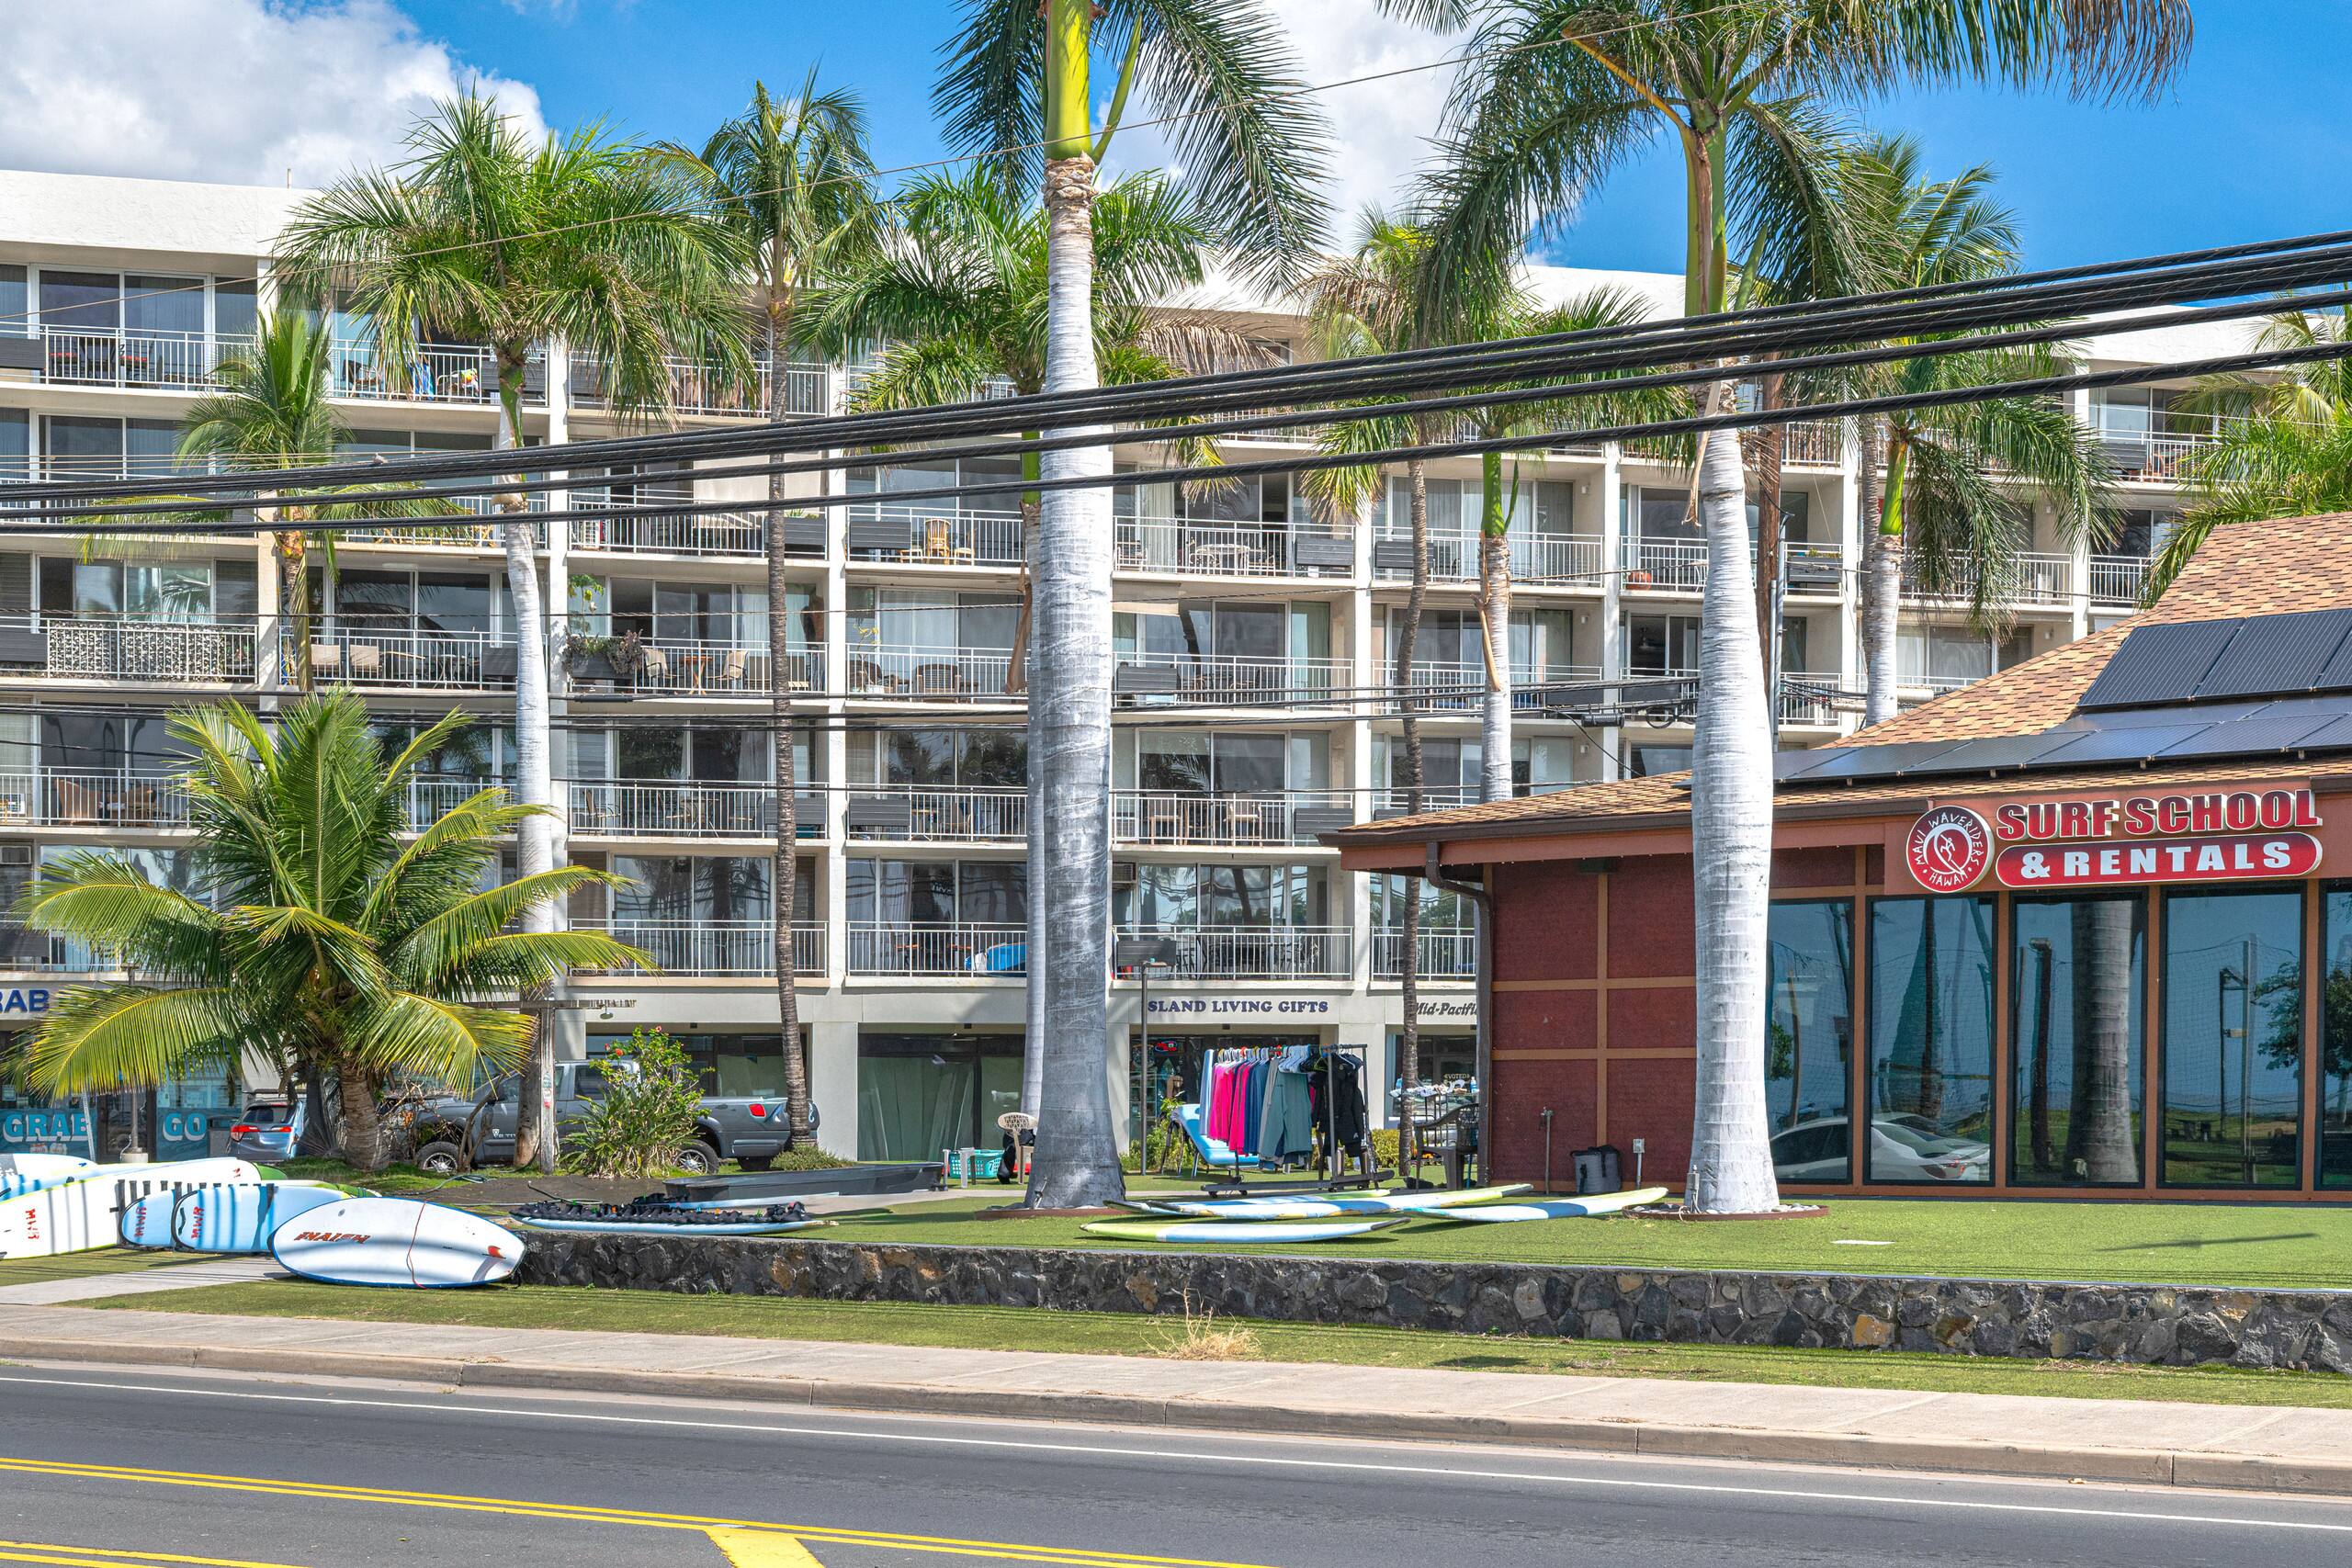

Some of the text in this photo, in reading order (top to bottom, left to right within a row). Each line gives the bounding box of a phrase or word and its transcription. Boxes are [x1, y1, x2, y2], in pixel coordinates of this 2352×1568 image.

[1996, 789, 2323, 840] SURF SCHOOL
[1912, 812, 1984, 866] MAUI WAVERIDERS
[2020, 841, 2291, 879] & RENTALS
[0, 989, 50, 1012] AB
[1146, 1000, 1329, 1013] SLAND LIVING GIFTS
[1416, 1002, 1477, 1016] Mid-Pacifi
[3, 1112, 208, 1143] GRAB GO
